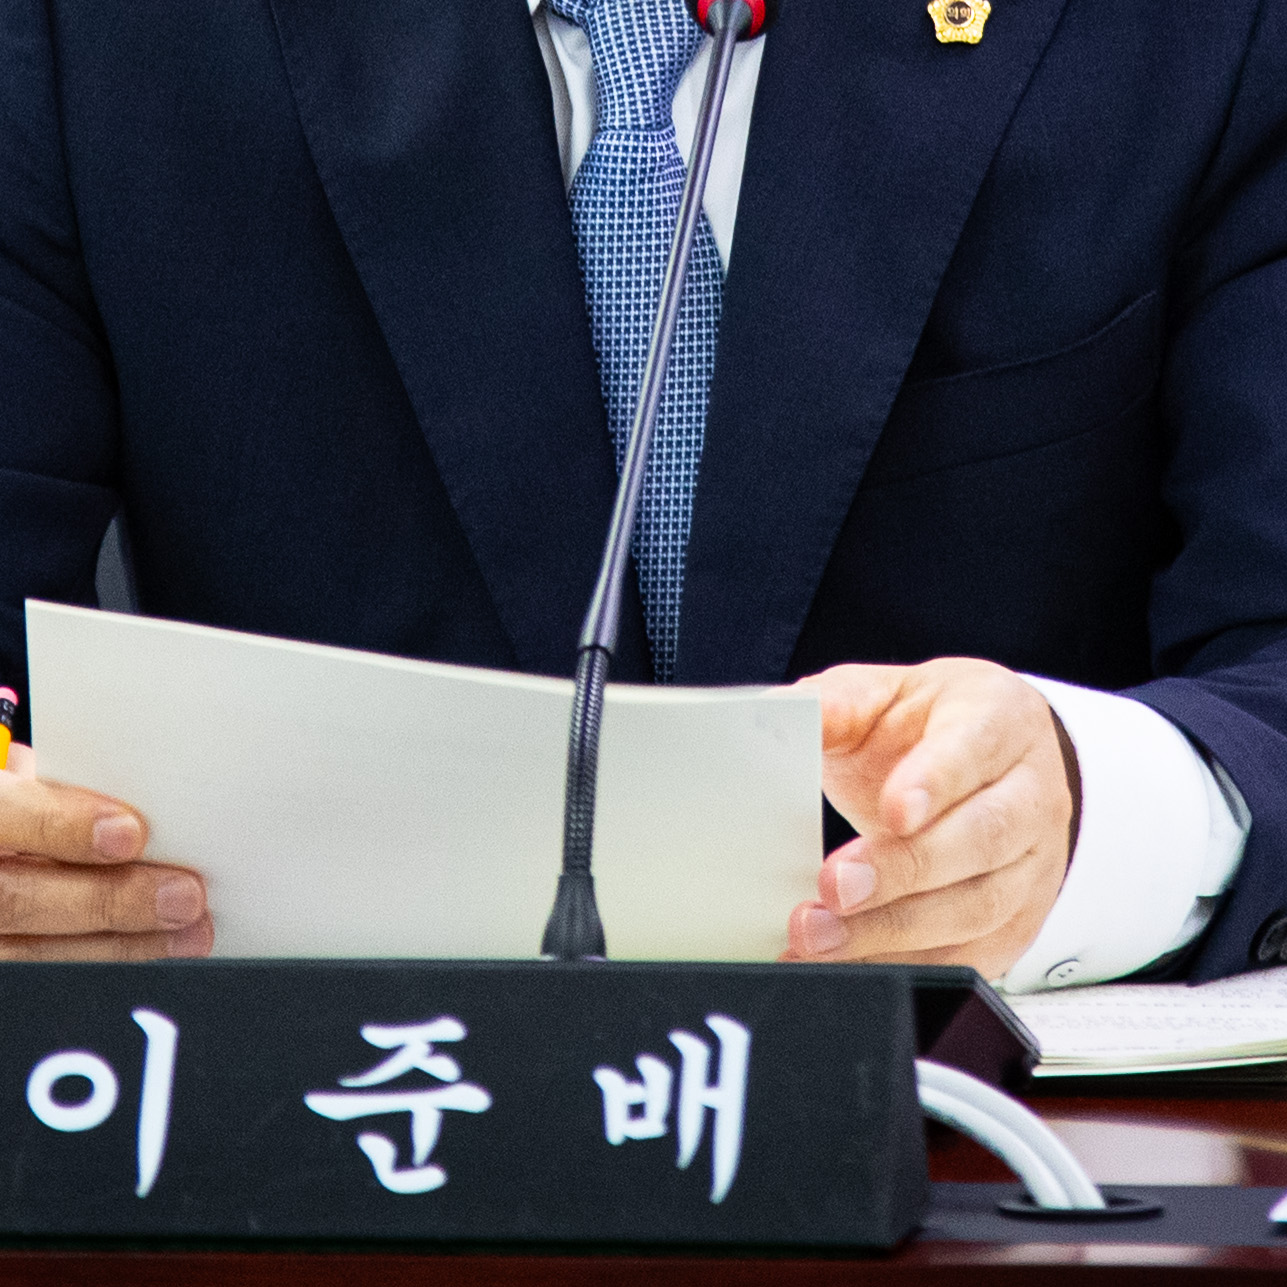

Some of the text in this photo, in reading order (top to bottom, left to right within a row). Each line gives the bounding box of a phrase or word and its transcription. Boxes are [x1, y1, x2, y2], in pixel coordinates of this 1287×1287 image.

[27, 1009, 751, 1202] 이 준 배
